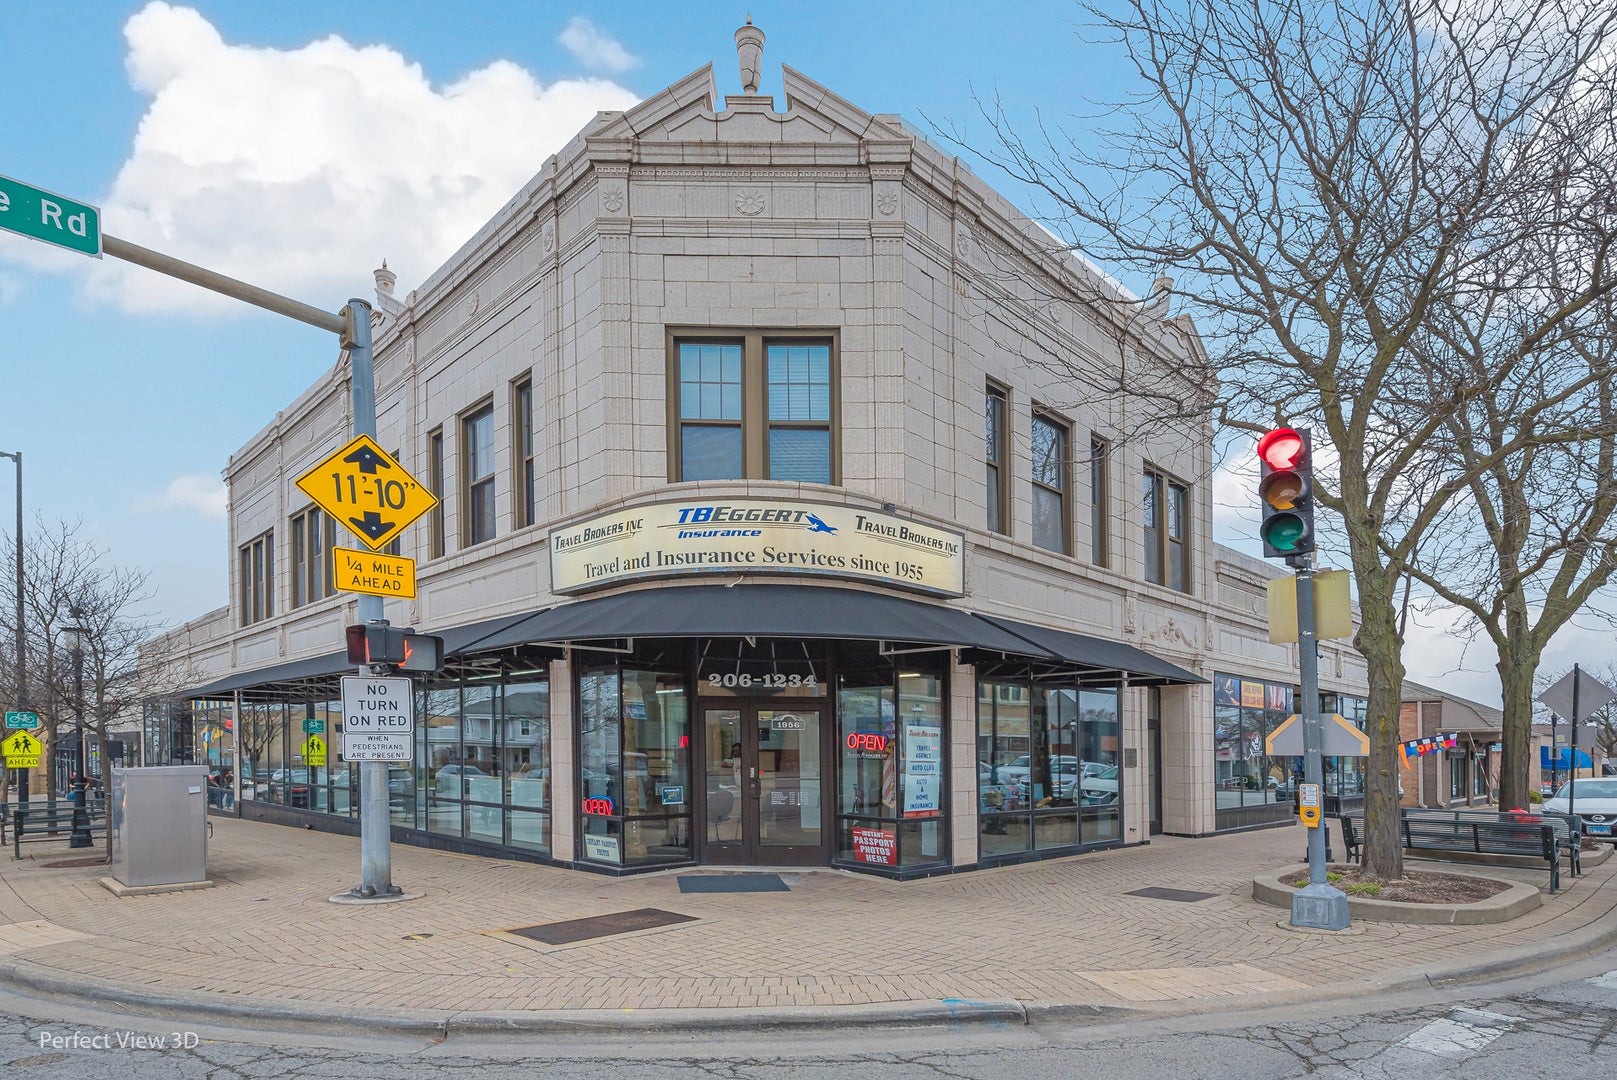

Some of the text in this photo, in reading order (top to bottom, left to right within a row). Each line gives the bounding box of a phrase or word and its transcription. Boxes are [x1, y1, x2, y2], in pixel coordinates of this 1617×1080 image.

[41, 198, 87, 237] Rd
[554, 518, 644, 551] TRAVEL BROKERS INC
[677, 529, 762, 540] Insurance
[855, 514, 959, 555] TRAVEL BROKERS INC
[372, 561, 404, 577] MILE
[584, 546, 924, 581] Travel and Insurance Services since 1955
[351, 575, 402, 591] AHEAD
[708, 673, 817, 688] 206-1234
[367, 685, 387, 695] NO
[358, 700, 398, 711] TURN
[350, 715, 407, 726] ON RED
[777, 721, 801, 729] 1956
[847, 733, 885, 750] OPEN
[1416, 741, 1445, 753] OPEN
[8, 758, 38, 766] AHEAD
[915, 793, 928, 801] HOME
[585, 799, 612, 816] OPEN
[861, 830, 884, 838] INSTANT
[854, 836, 893, 847] PASSPORT
[860, 845, 891, 856] PHOTOS
[865, 854, 889, 864] HERE
